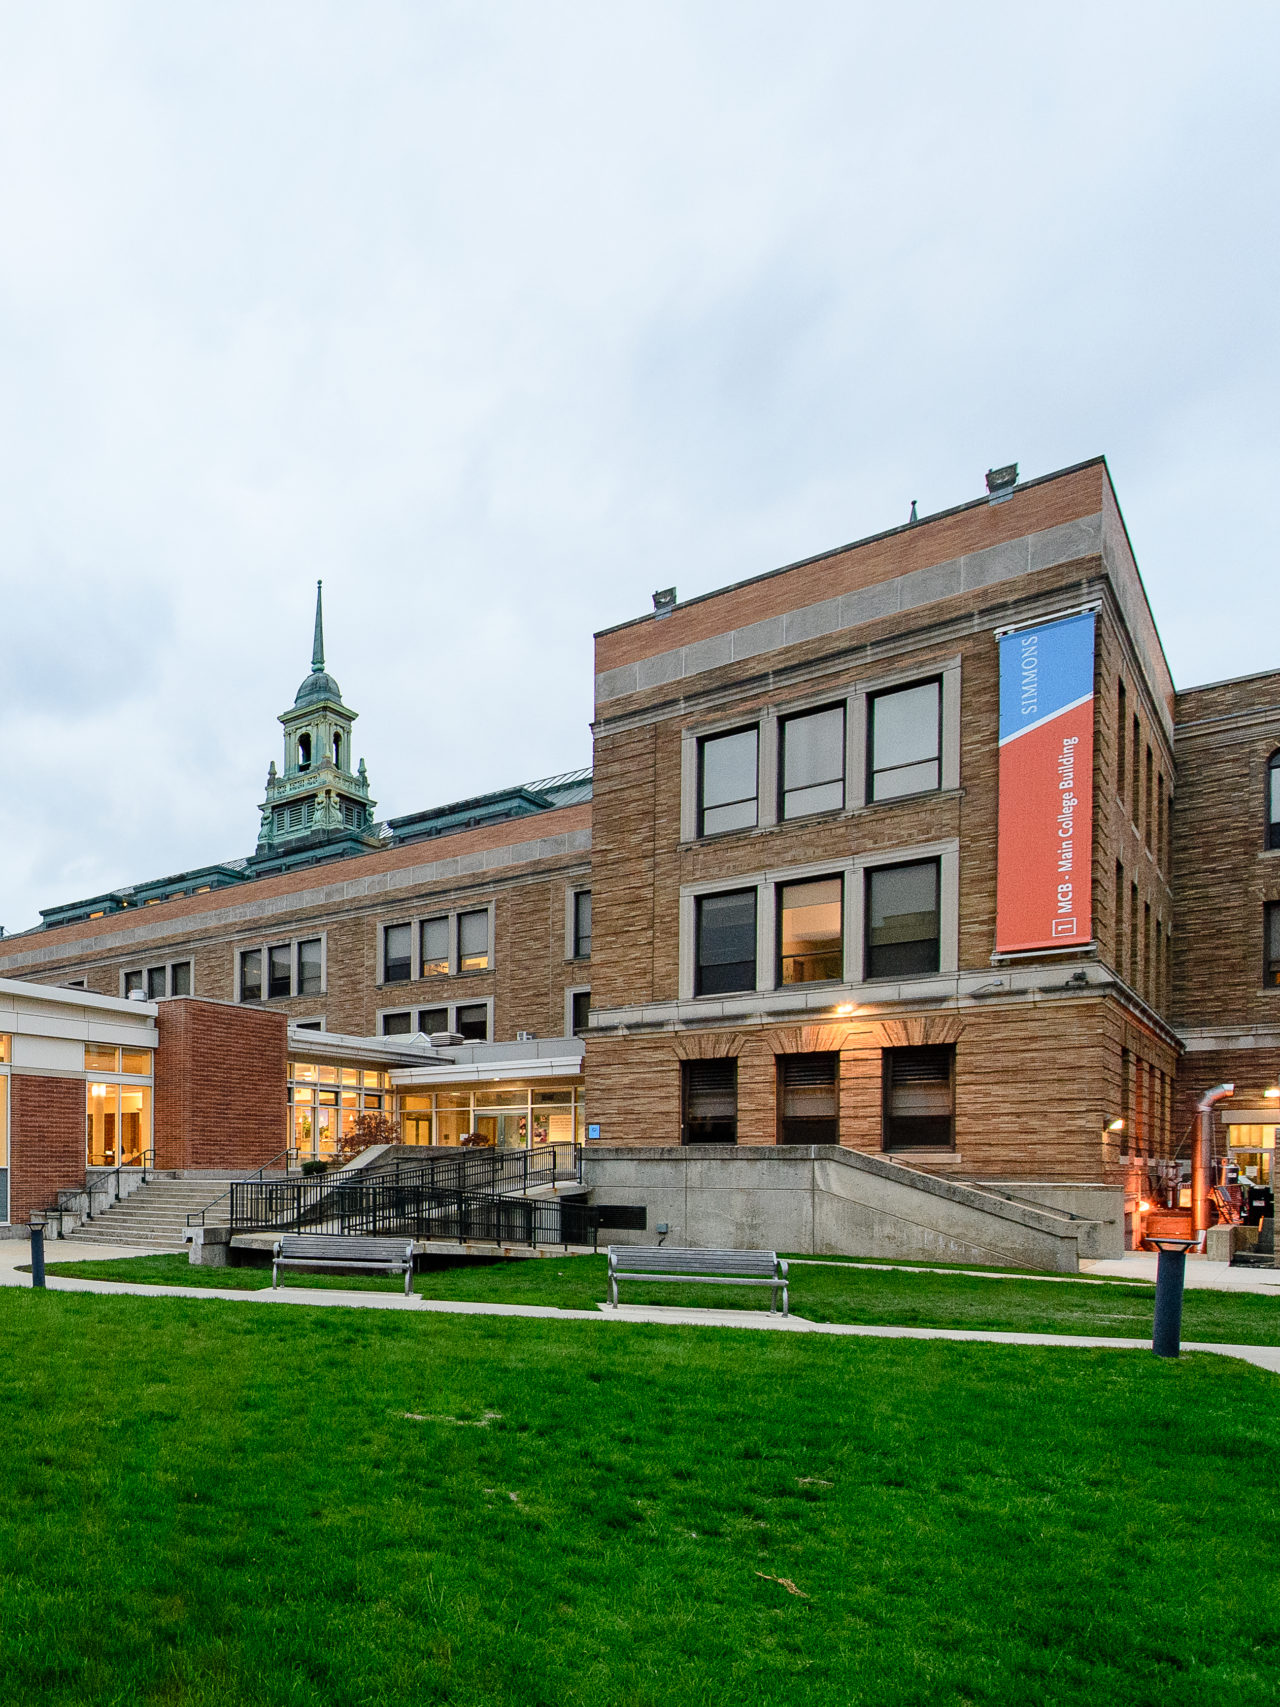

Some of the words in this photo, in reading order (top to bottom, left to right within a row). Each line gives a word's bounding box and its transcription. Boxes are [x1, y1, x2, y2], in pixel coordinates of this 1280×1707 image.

[1021, 635, 1038, 715] SIMMONS
[1057, 736, 1079, 790] Building
[1056, 791, 1078, 838] College
[1057, 840, 1073, 872] Main
[1057, 882, 1073, 914] MCB
